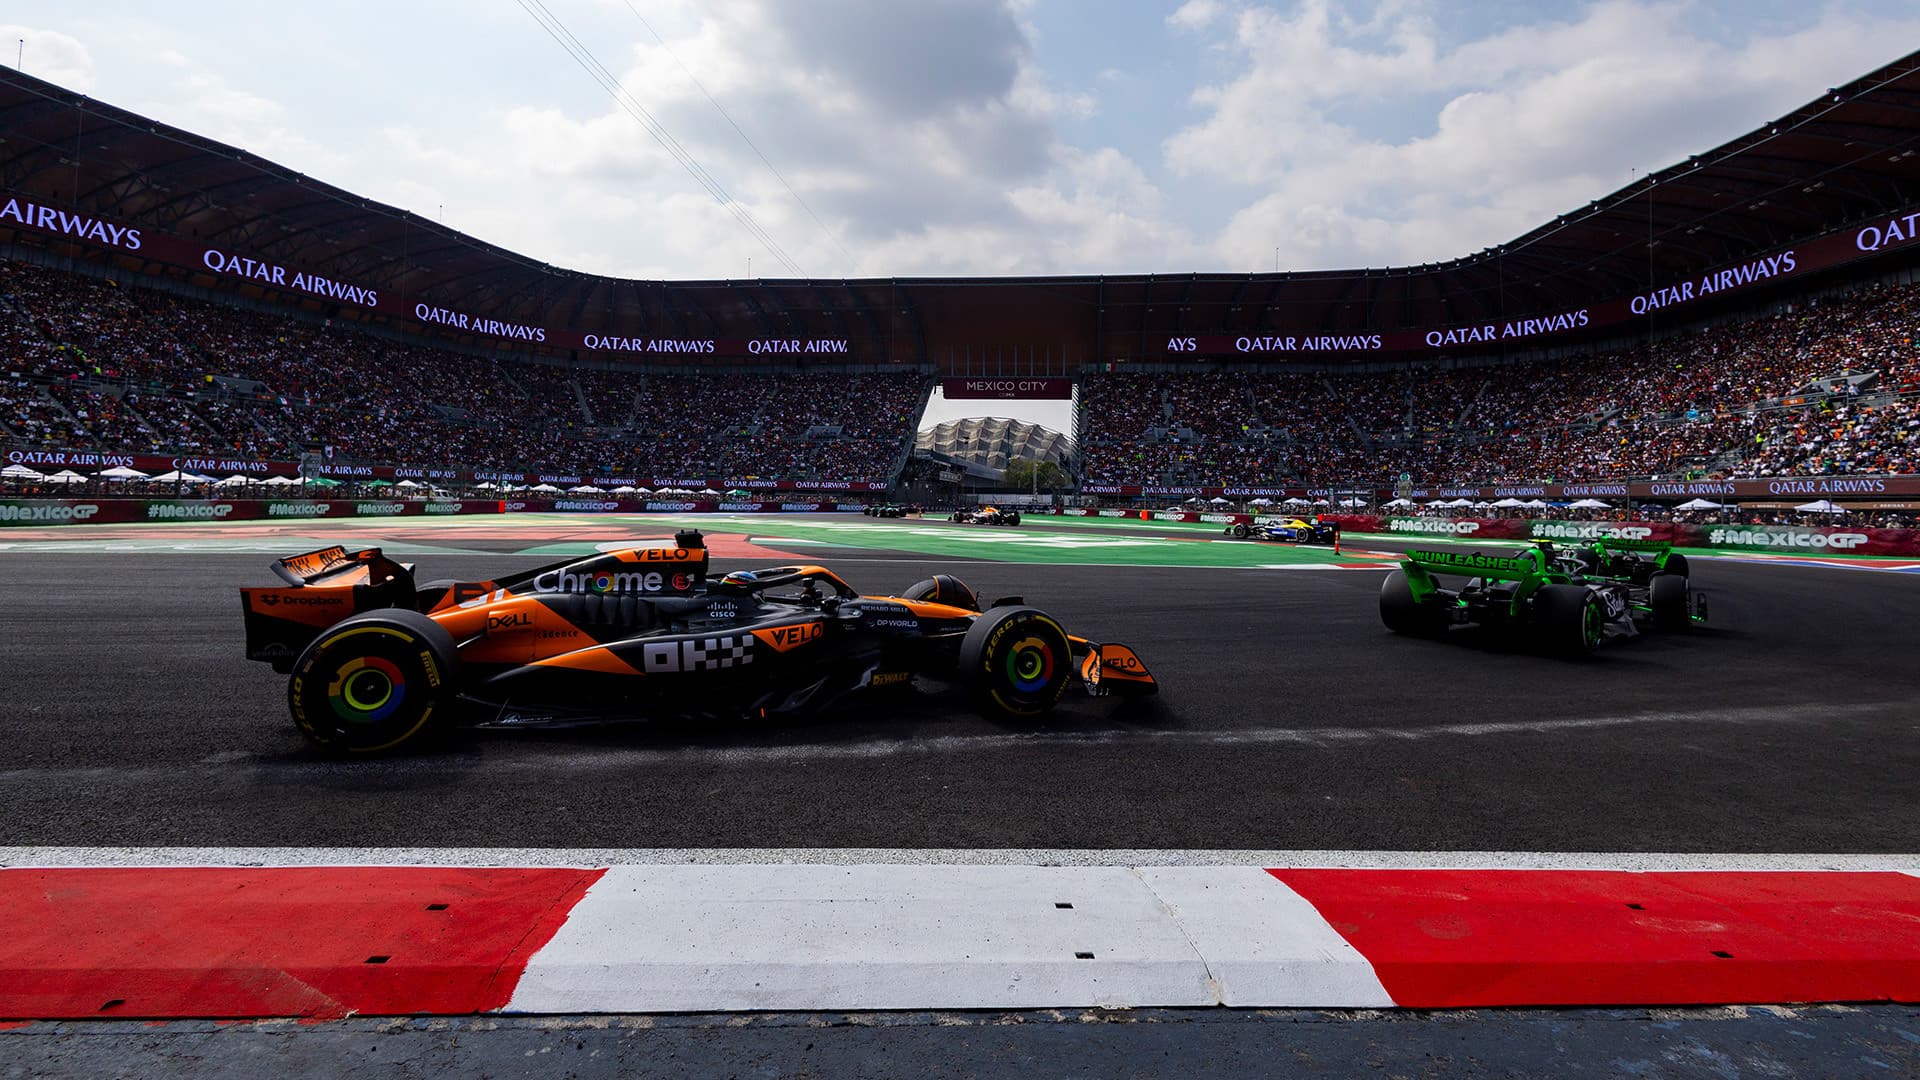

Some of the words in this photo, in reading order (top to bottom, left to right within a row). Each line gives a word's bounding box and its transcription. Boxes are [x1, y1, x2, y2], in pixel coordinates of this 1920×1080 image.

[0, 198, 142, 250] AIRWAYS
[1856, 212, 1920, 251] QAT
[203, 249, 286, 286] QATAR
[291, 272, 377, 307] AIRWAYS
[1630, 281, 1695, 315] QATAR
[1699, 250, 1796, 296] AIRWAYS
[415, 303, 469, 330] QATAR
[471, 317, 546, 342] AIRWAYS
[1425, 325, 1497, 347] QATAR
[1502, 309, 1589, 338] AIRWAYS
[583, 334, 642, 352] QATAR
[646, 339, 714, 353] AIRWAYS
[747, 339, 801, 354] QATAR
[1235, 337, 1297, 352] QATAR
[1301, 335, 1382, 350] AIRWAYS
[966, 381, 1015, 391] MEXICO
[1018, 381, 1048, 391] CITY
[9, 451, 66, 464] QATAR
[395, 468, 423, 478] QATAR
[539, 475, 558, 483] QATAR
[724, 480, 748, 488] QATAR
[795, 481, 819, 489] QATAR
[1563, 485, 1589, 496] QATAR
[1591, 484, 1626, 495] AIRWAYS
[1651, 484, 1686, 495] QATAR
[1688, 482, 1736, 494] AIRWAYS
[1769, 481, 1815, 494] QATAR
[1819, 479, 1885, 493] AIRWAYS
[1439, 489, 1457, 497] QATAR
[1494, 488, 1516, 497] QATAR
[1516, 487, 1545, 496] AIRWAYS
[148, 504, 233, 518] #MexicoGP
[268, 503, 330, 515] #MexicoGP
[357, 503, 404, 514] #MexicoGP
[424, 503, 462, 513] #MexicoGP
[554, 501, 619, 510] #MexicoGP
[646, 502, 696, 511] #MexicoGP
[718, 503, 762, 511] #MexicoGP
[1389, 519, 1480, 534] #MexicoGP
[1708, 529, 1869, 549] #MexicoGP
[633, 548, 690, 560] VELO
[1416, 550, 1520, 570] #UNLEASHED
[533, 566, 663, 593] Chrome
[283, 595, 345, 607] Dropbox
[488, 613, 533, 629] DELL
[535, 630, 580, 639] cadence
[771, 623, 822, 646] VELO
[986, 619, 1014, 658] ZERO
[420, 650, 440, 688] PIRELLI
